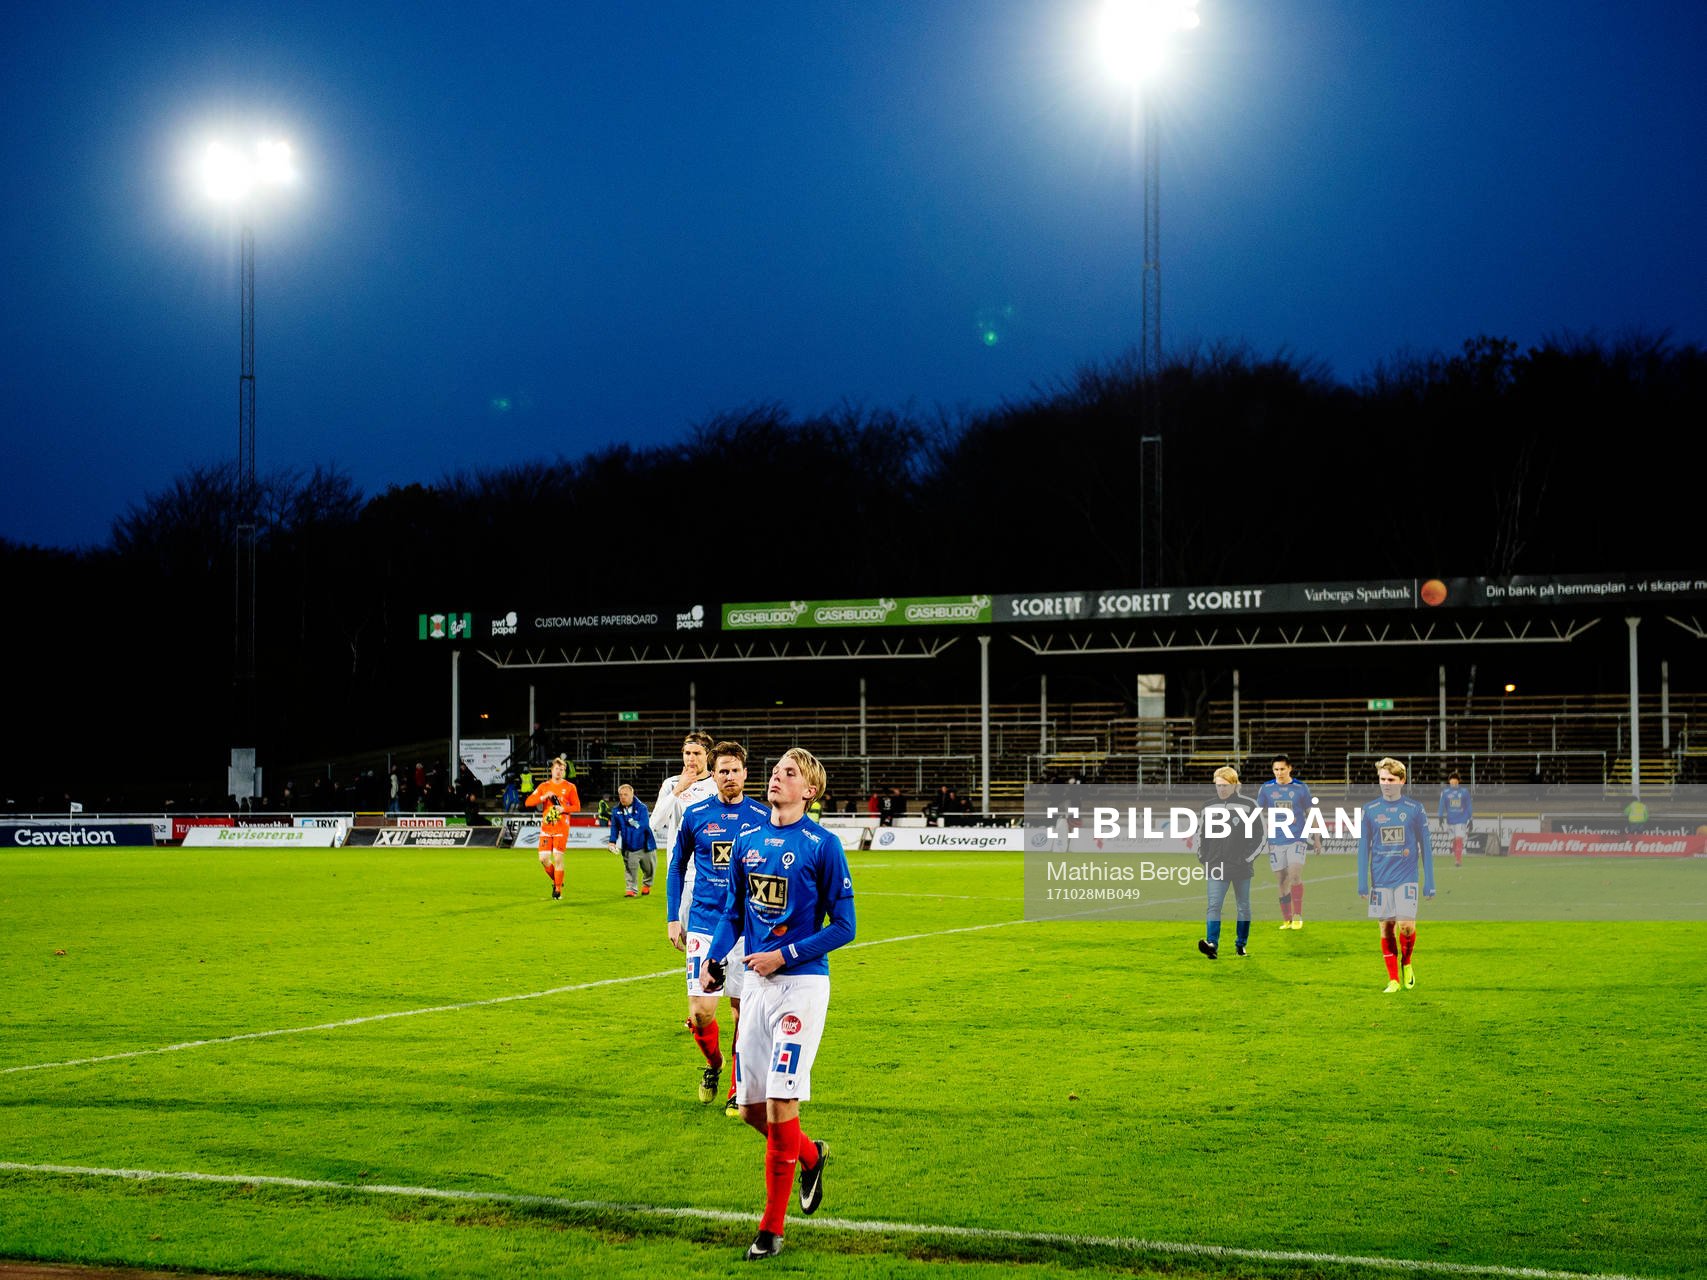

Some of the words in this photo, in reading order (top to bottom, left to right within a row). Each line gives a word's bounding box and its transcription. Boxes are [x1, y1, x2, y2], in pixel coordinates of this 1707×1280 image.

[1304, 588, 1354, 603] Varbergs
[1356, 586, 1411, 602] Sparbank
[1486, 585, 1505, 597] Din
[1508, 583, 1537, 597] bank
[1540, 583, 1555, 597] på
[1557, 580, 1626, 595] hemmaplan
[1637, 580, 1648, 592] vi
[1650, 579, 1692, 594] skapar
[1011, 597, 1082, 617] SCORETT
[1098, 593, 1171, 613] SCORETT
[1188, 590, 1262, 610] SCORETT
[535, 617, 571, 628] CUSTOM
[573, 616, 599, 627] MADE
[600, 614, 658, 626] PAPERBOARD
[728, 609, 799, 627] CASHBUDDY
[815, 606, 887, 624] CASHBUDDY
[906, 603, 980, 621] CASHBUDDY
[491, 626, 517, 636] paper
[676, 620, 704, 630] paper
[14, 828, 116, 846] Caverion
[217, 829, 304, 841] Revisorerna
[919, 834, 1007, 848] Volkswagen
[1515, 838, 1563, 852] Framåt
[1587, 840, 1632, 853] svensk
[753, 879, 784, 905] XL
